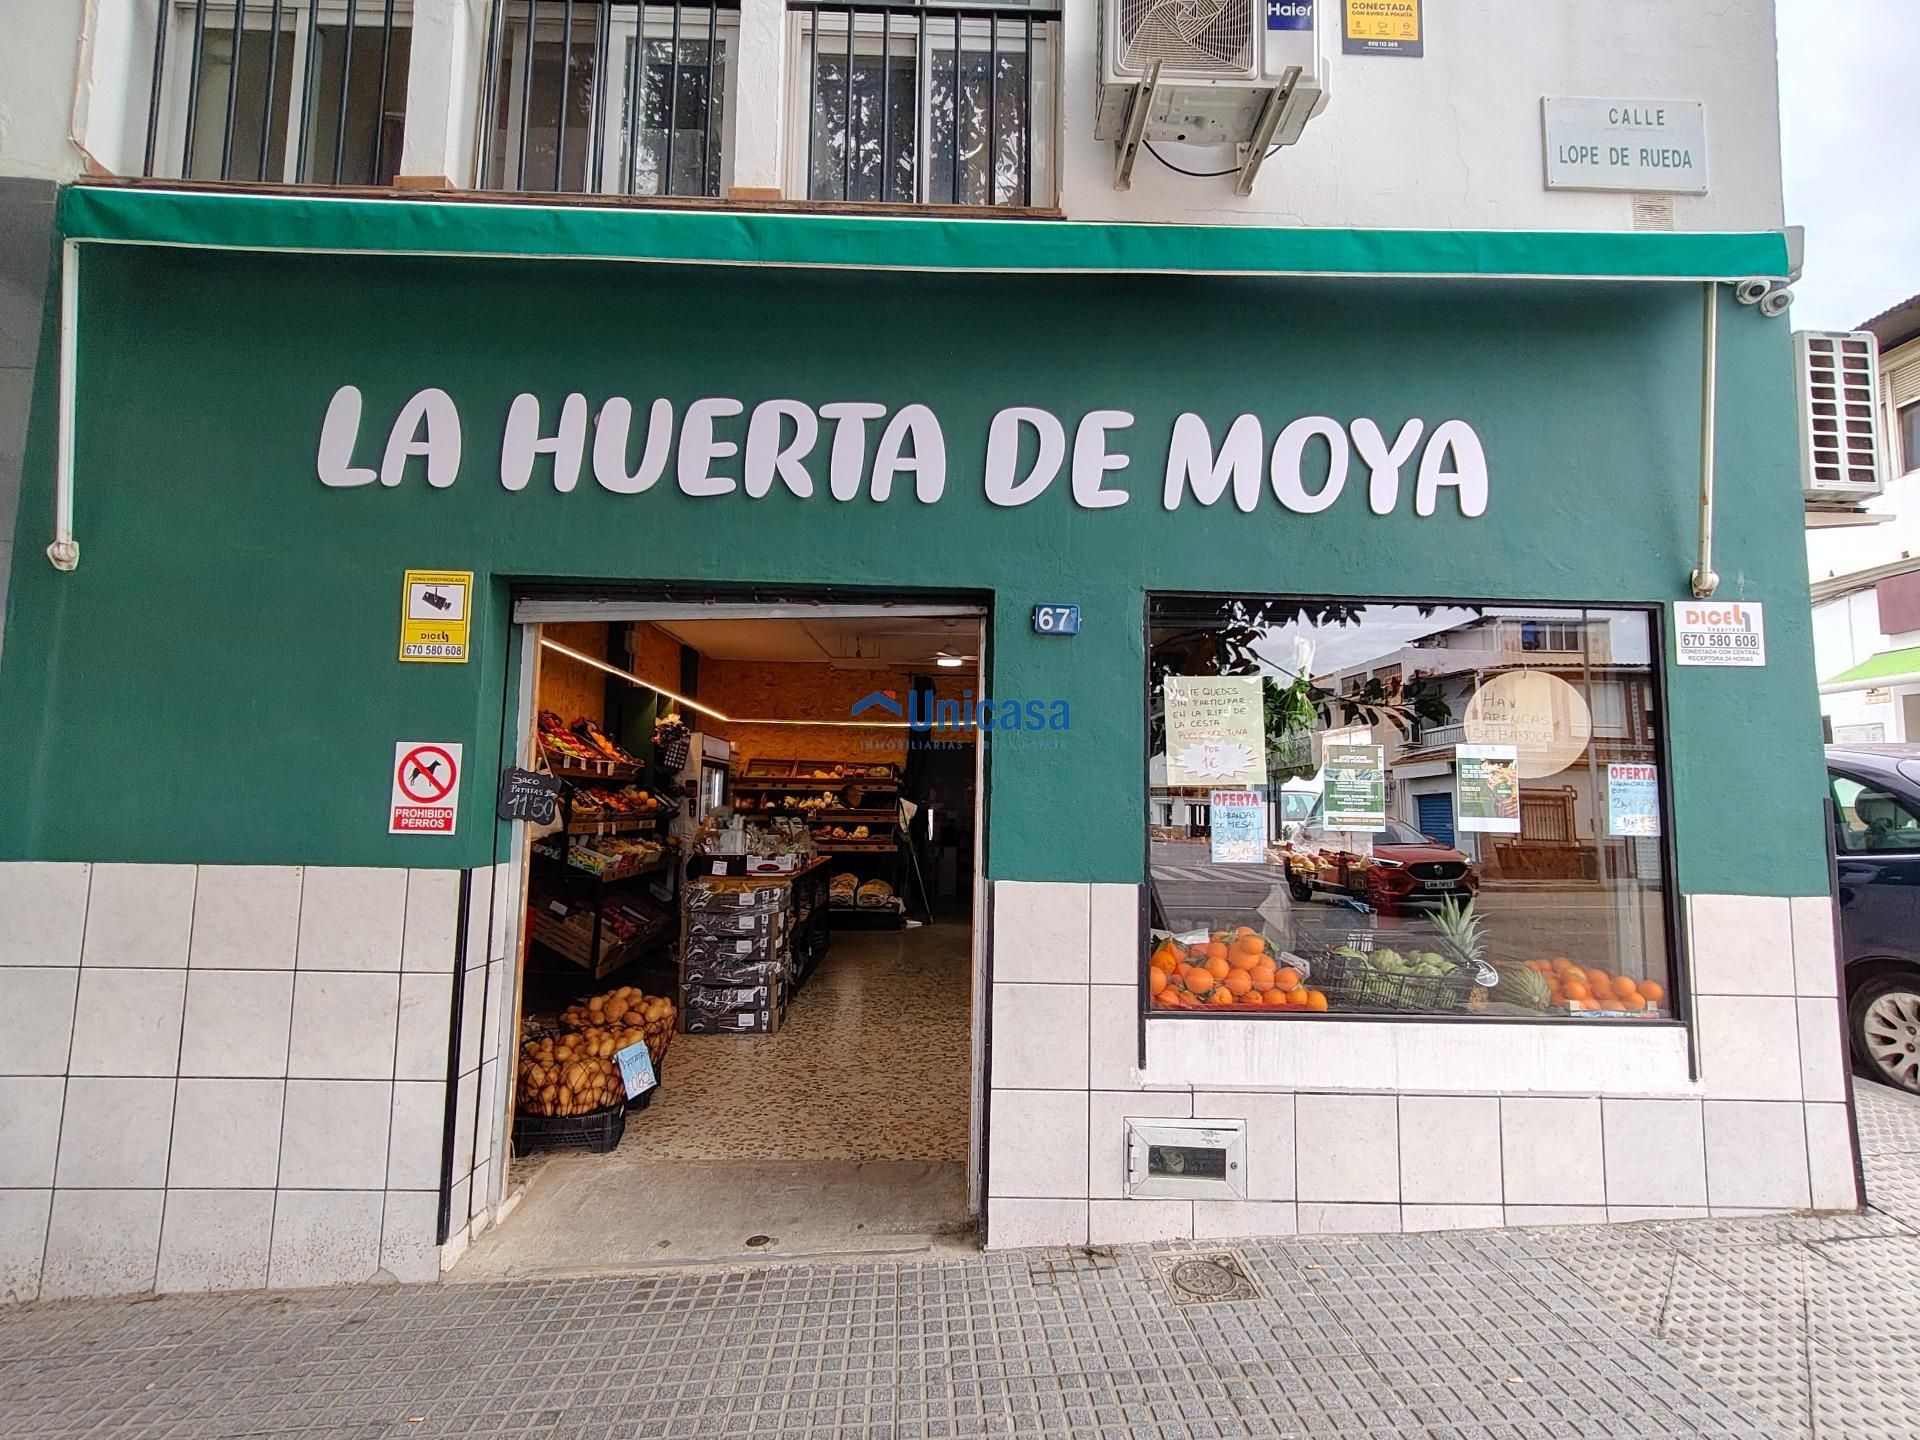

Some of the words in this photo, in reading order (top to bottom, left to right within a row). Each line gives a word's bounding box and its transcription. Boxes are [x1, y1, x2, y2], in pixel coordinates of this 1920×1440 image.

[1268, 3, 1313, 17] Haier
[1351, 3, 1413, 12] CONECTADA
[1609, 108, 1665, 126] CALLE
[1559, 145, 1599, 165] LOPE
[1609, 147, 1630, 166] DE
[1640, 148, 1692, 168] RUEDA
[318, 386, 461, 488] LA
[501, 393, 946, 504] HUERTA
[985, 407, 1134, 508] DE
[1164, 413, 1488, 517] MOYA
[1038, 607, 1069, 631] 67
[1683, 634, 1705, 646] 670
[1709, 635, 1731, 646] 580
[1735, 635, 1757, 647] 608
[406, 645, 423, 655] 670
[425, 645, 443, 655] 580
[445, 646, 462, 656] 608
[1170, 687, 1185, 697] NO
[1190, 687, 1199, 696] TE
[1202, 687, 1239, 697] QUEDES
[1192, 698, 1246, 707] PARTICIPAR
[1234, 707, 1247, 715] DE
[1174, 721, 1185, 729] LA
[1190, 719, 1220, 728] CESTA
[1204, 745, 1220, 753] POR
[1202, 757, 1218, 768] 1€
[1611, 766, 1656, 780] OFERTA
[510, 784, 543, 796] PATATAS
[1213, 793, 1259, 806] OFERTA
[395, 808, 453, 819] PROHIBIDO
[1214, 809, 1256, 820] NARANJAS
[401, 818, 445, 829] PERROS
[1227, 820, 1254, 830] MESA
